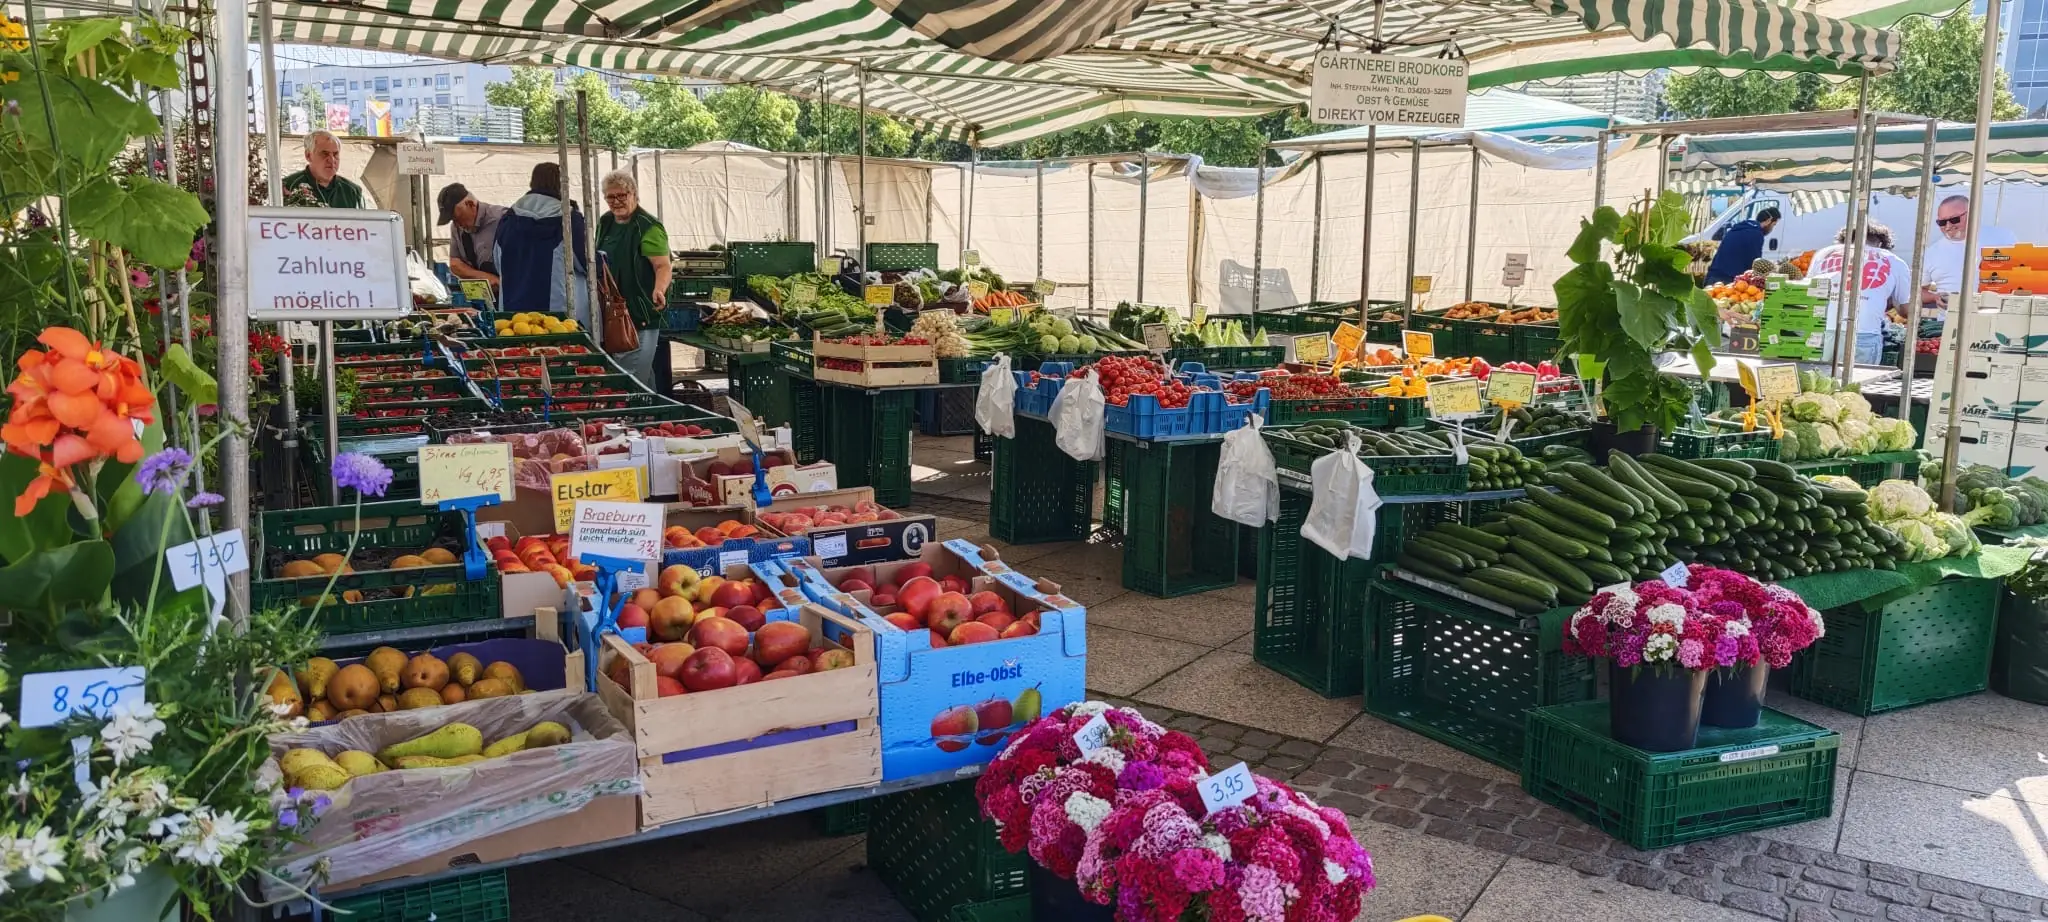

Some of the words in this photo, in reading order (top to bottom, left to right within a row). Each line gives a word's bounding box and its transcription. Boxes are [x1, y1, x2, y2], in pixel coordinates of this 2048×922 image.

[1398, 61, 1464, 77] BRODKORB
[1370, 74, 1420, 86] ZWENKAU
[1356, 94, 1382, 104] OBST
[1392, 95, 1430, 107] GEMÜSE
[1318, 107, 1366, 121] DIREKT
[1368, 110, 1395, 122] VOM
[1398, 109, 1461, 124] ERZEUGER
[260, 222, 377, 241] EC-Karten-
[277, 256, 366, 278] Zahlung
[274, 290, 360, 309] möglich
[368, 290, 374, 308] !
[558, 480, 613, 500] Elstar
[583, 507, 646, 524] Braeburn
[951, 663, 1023, 688] Elbe-Obst
[1210, 773, 1244, 803] 3,95
